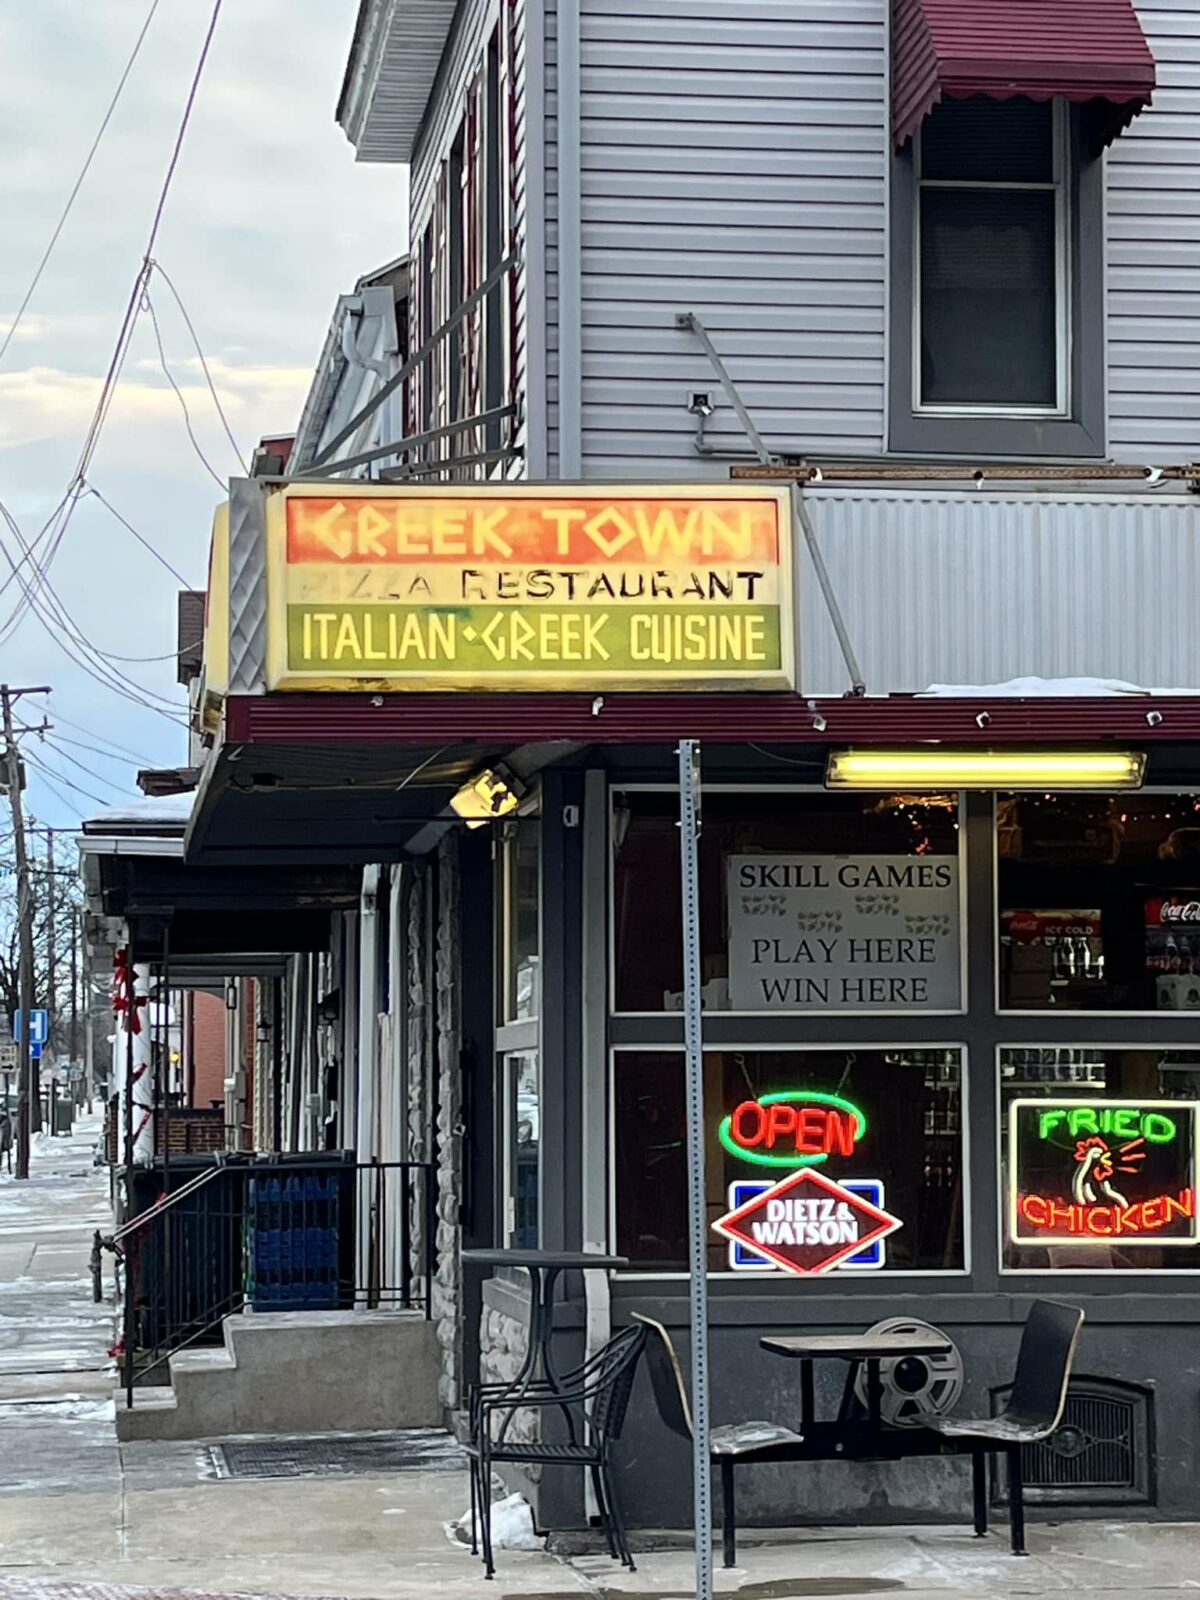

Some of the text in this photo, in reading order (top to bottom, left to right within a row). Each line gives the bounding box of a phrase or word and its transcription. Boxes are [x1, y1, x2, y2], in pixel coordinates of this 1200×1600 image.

[312, 502, 753, 559] GREEK TOWN
[461, 569, 765, 600] RESTAURANT
[302, 609, 767, 664] ITALIAN GREEK CUISINE
[739, 864, 952, 889] SKILL GAMES
[751, 938, 936, 964] PLAY HERE
[760, 977, 929, 1004] WIN HERE
[732, 1101, 859, 1157] OPEN
[1038, 1107, 1177, 1143] FRIED
[1019, 1188, 1196, 1235] CHICKEN
[752, 1221, 859, 1246] WATSON
